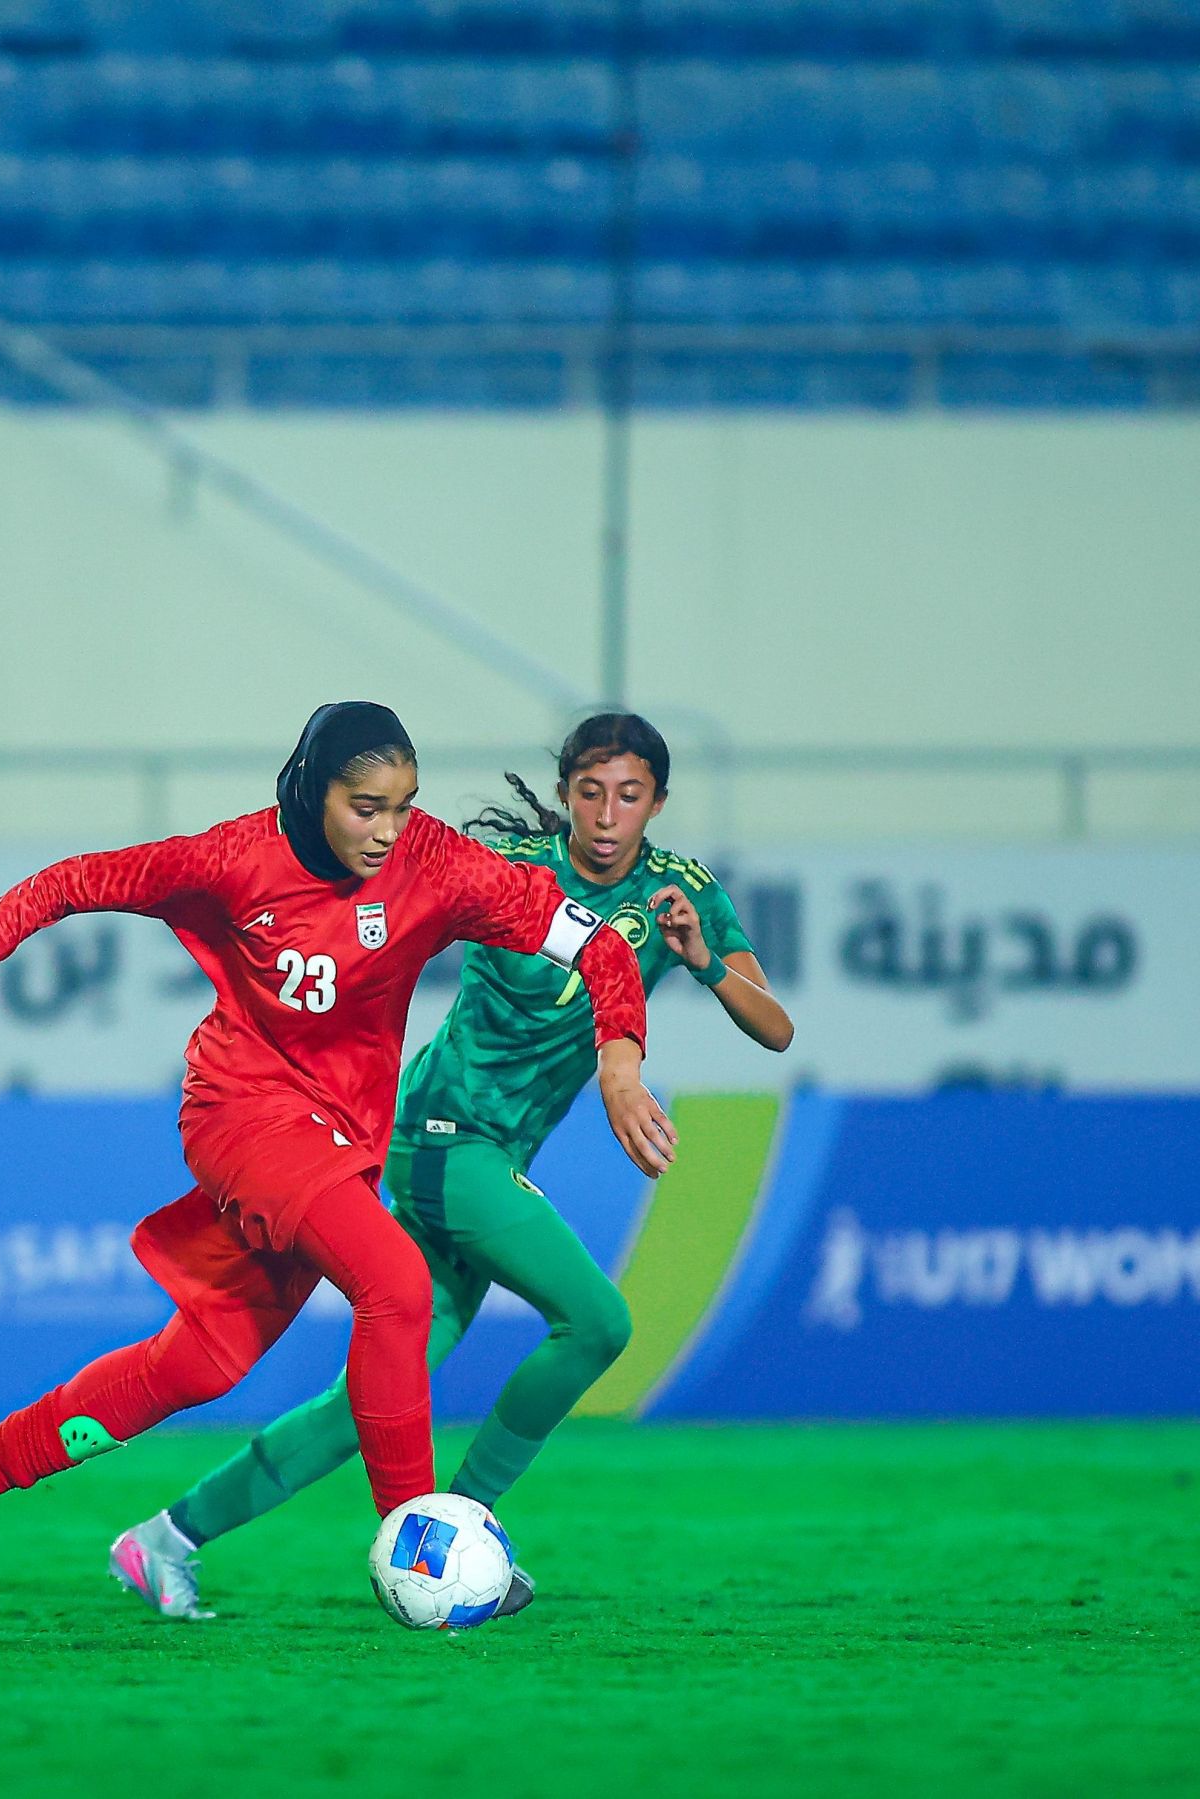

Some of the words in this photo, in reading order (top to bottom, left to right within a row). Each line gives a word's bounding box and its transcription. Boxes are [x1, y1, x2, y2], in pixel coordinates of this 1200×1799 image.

[565, 903, 596, 927] C
[276, 949, 337, 1013] 23
[838, 880, 1140, 1025] مدينة
